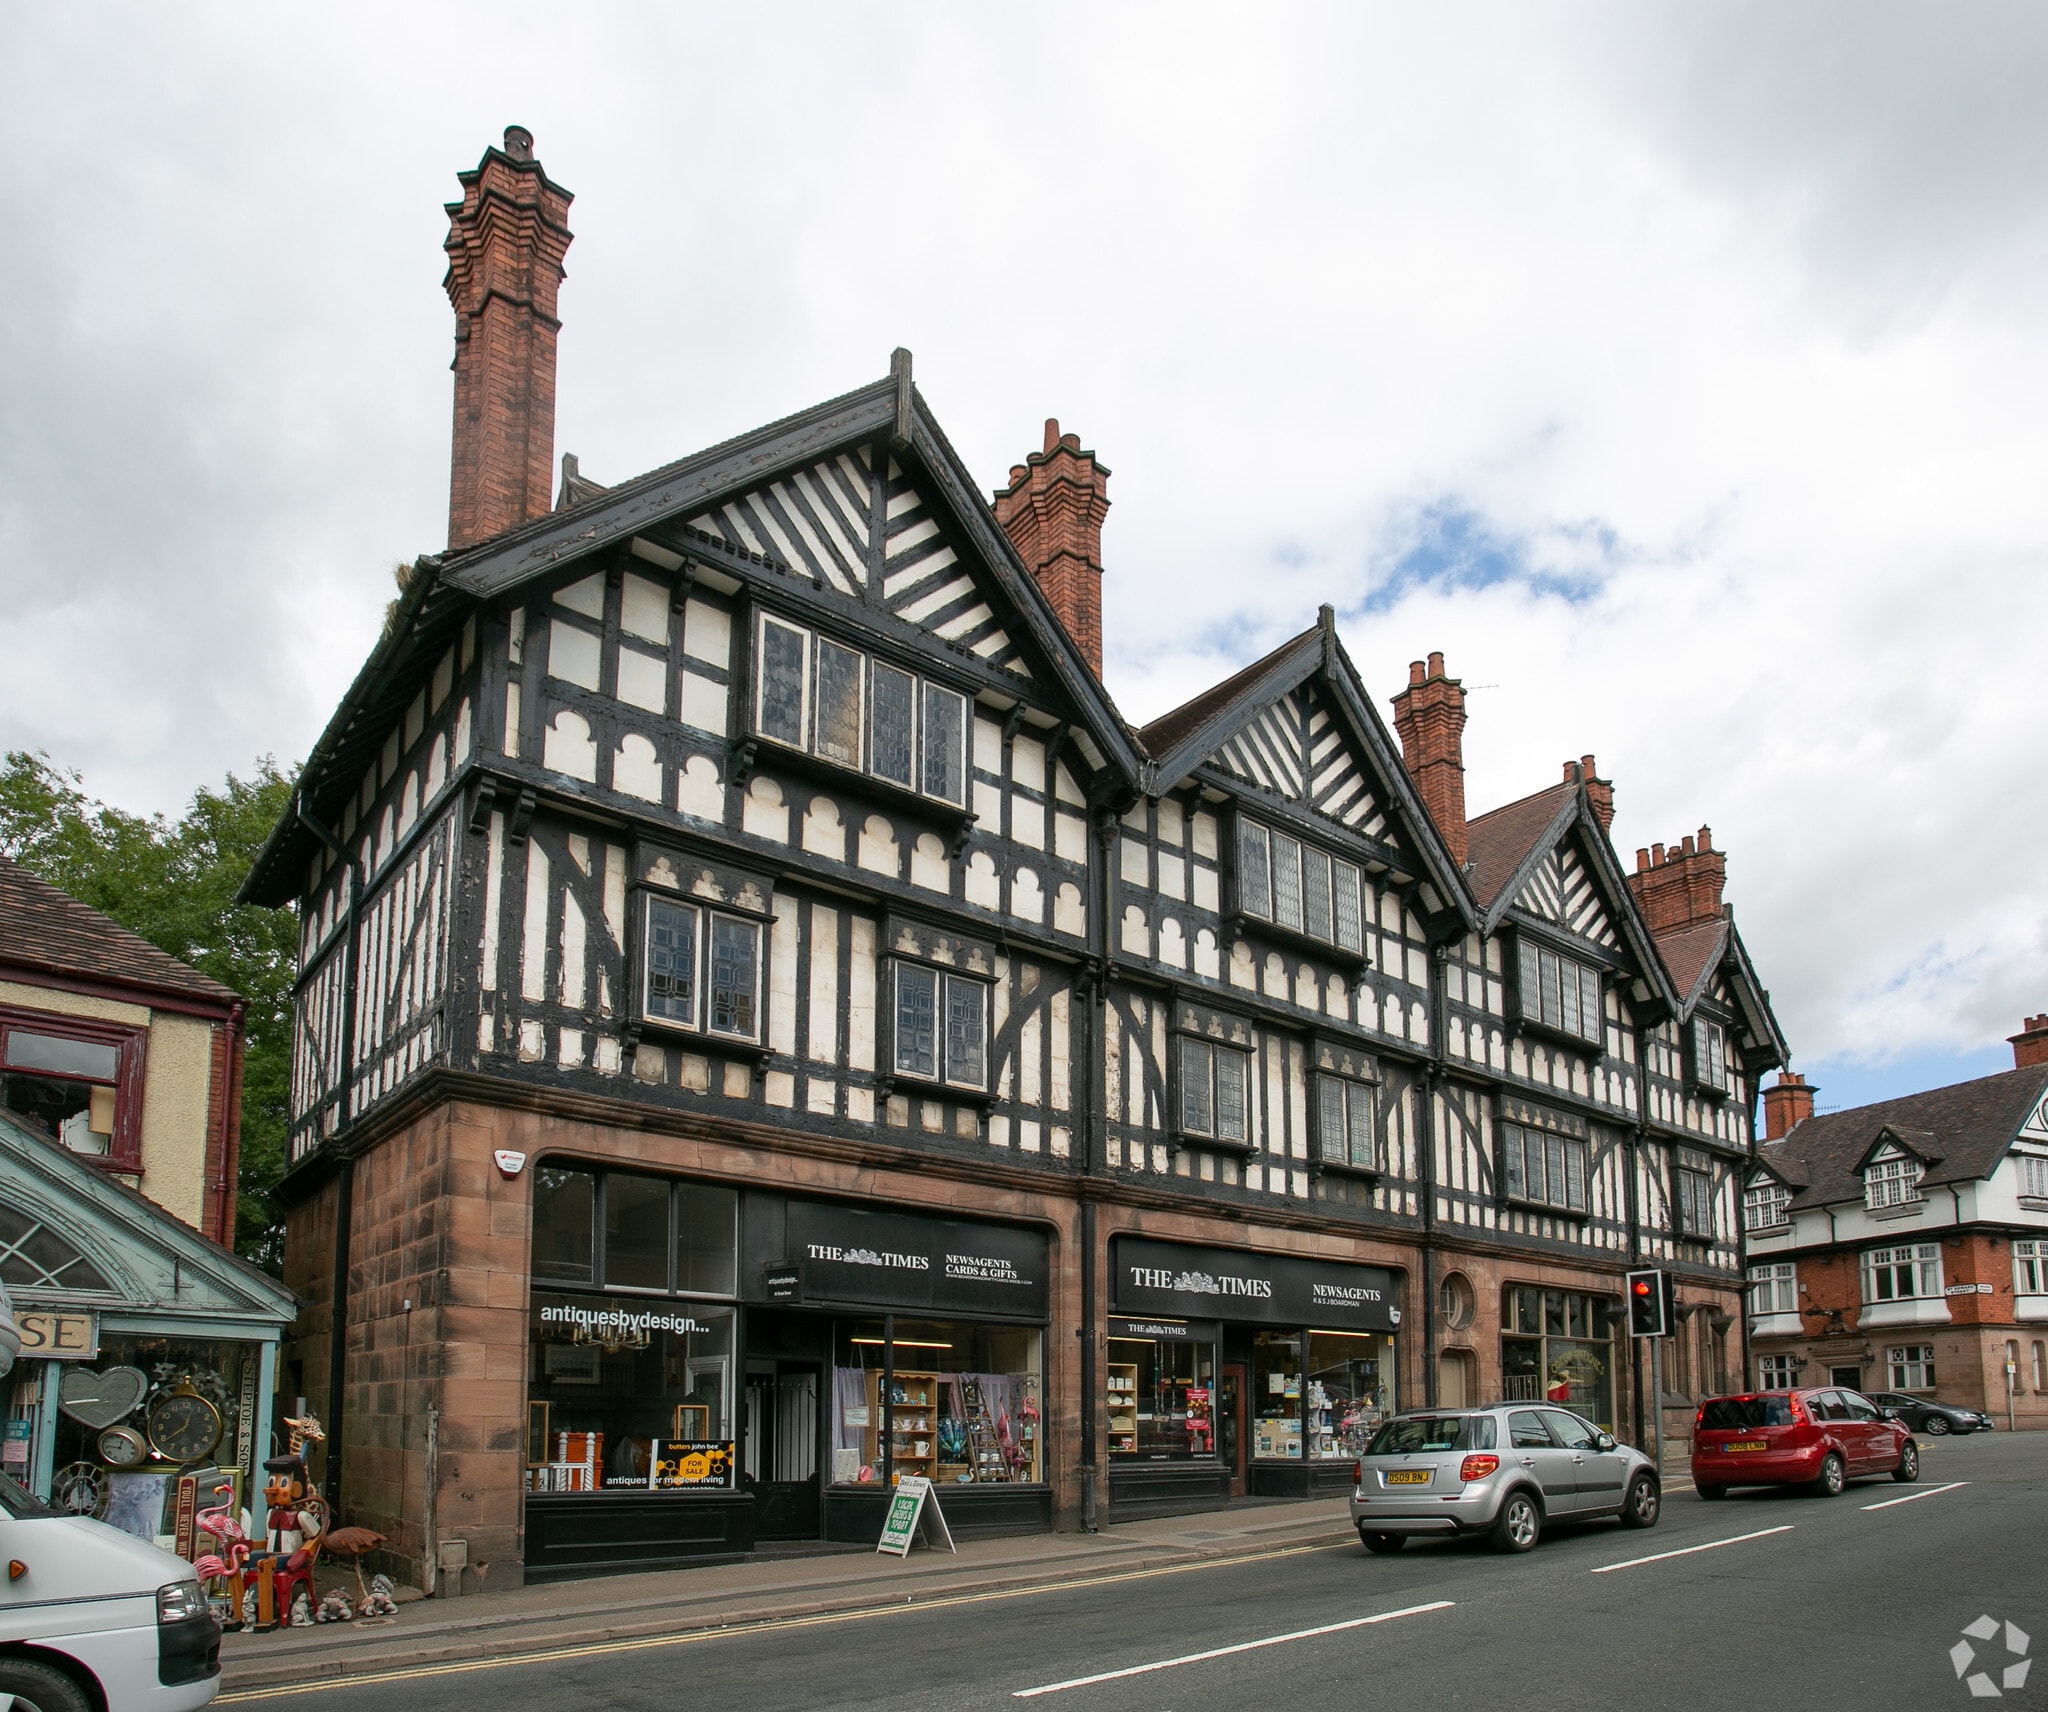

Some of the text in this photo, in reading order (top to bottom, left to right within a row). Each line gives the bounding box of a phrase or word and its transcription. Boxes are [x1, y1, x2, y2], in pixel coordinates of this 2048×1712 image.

[807, 1244, 929, 1270] THE TIMES
[946, 1254, 1011, 1269] NEWSAGENTS
[945, 1264, 1017, 1279] CARDS & GIFTS
[1130, 1266, 1272, 1298] THE TIMES
[1313, 1284, 1381, 1301] NEWSAGENTS
[1330, 1299, 1360, 1307] BOARDMAN
[541, 1305, 709, 1335] antiquesbydesign...
[1128, 1323, 1187, 1335] THE TIMES
[240, 1366, 254, 1426] STEPTOE
[161, 1412, 171, 1420] 10
[181, 1446, 188, 1454] 6
[606, 1475, 647, 1485] antiques
[663, 1475, 699, 1484] modern
[701, 1475, 724, 1485] living
[1389, 1473, 1429, 1481] DS09 BNJ
[181, 1485, 193, 1508] YOULL
[898, 1500, 913, 1510] LOCAL
[892, 1509, 908, 1520] NEWS
[179, 1514, 190, 1537] NEVER
[891, 1519, 909, 1530] SPORT
